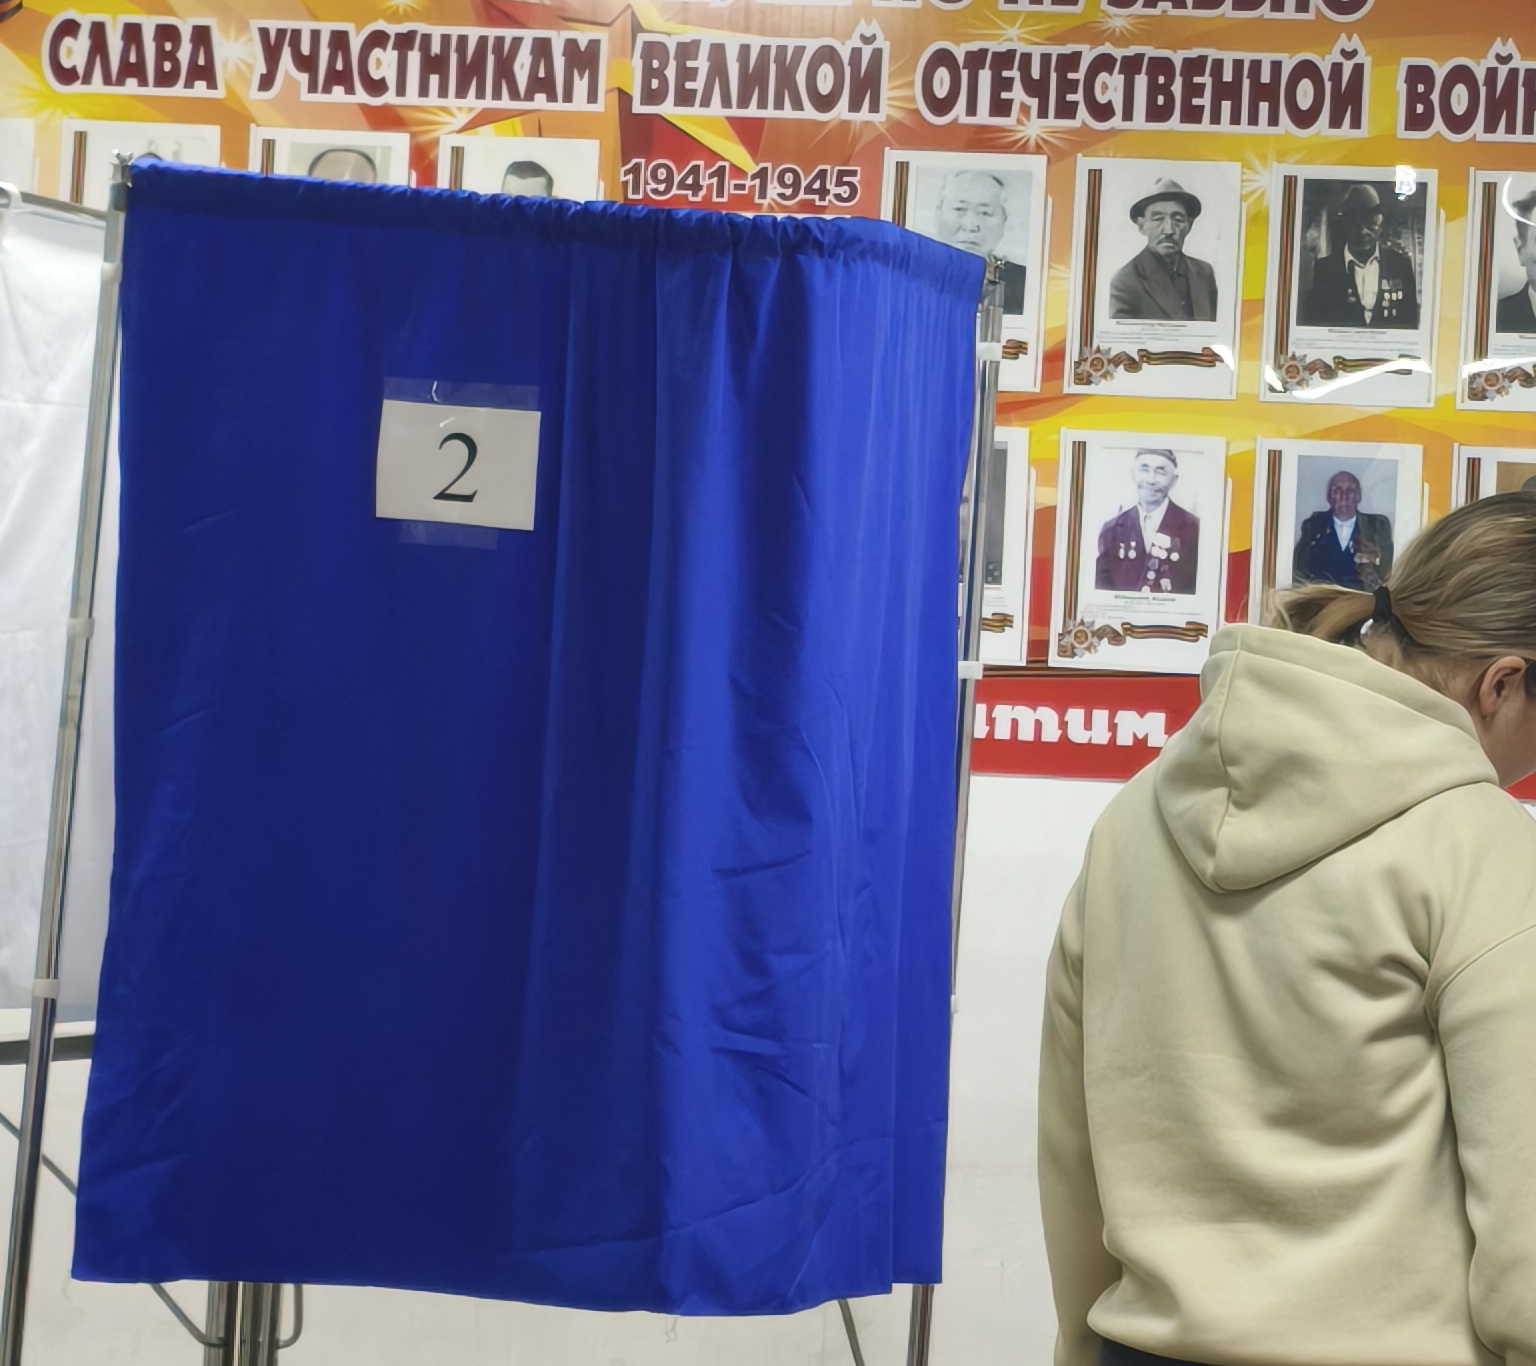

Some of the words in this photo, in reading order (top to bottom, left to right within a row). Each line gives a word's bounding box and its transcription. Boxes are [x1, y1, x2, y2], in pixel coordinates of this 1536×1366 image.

[48, 17, 219, 92] СЛАВА
[257, 26, 604, 106] УЧАСТНИКАМ
[637, 31, 884, 114] ВЕЛИКОЙ
[920, 44, 1367, 132] ОТЕЧЕСТВЕННОЙ
[623, 160, 859, 204] 1941-1945
[432, 432, 478, 503] 2
